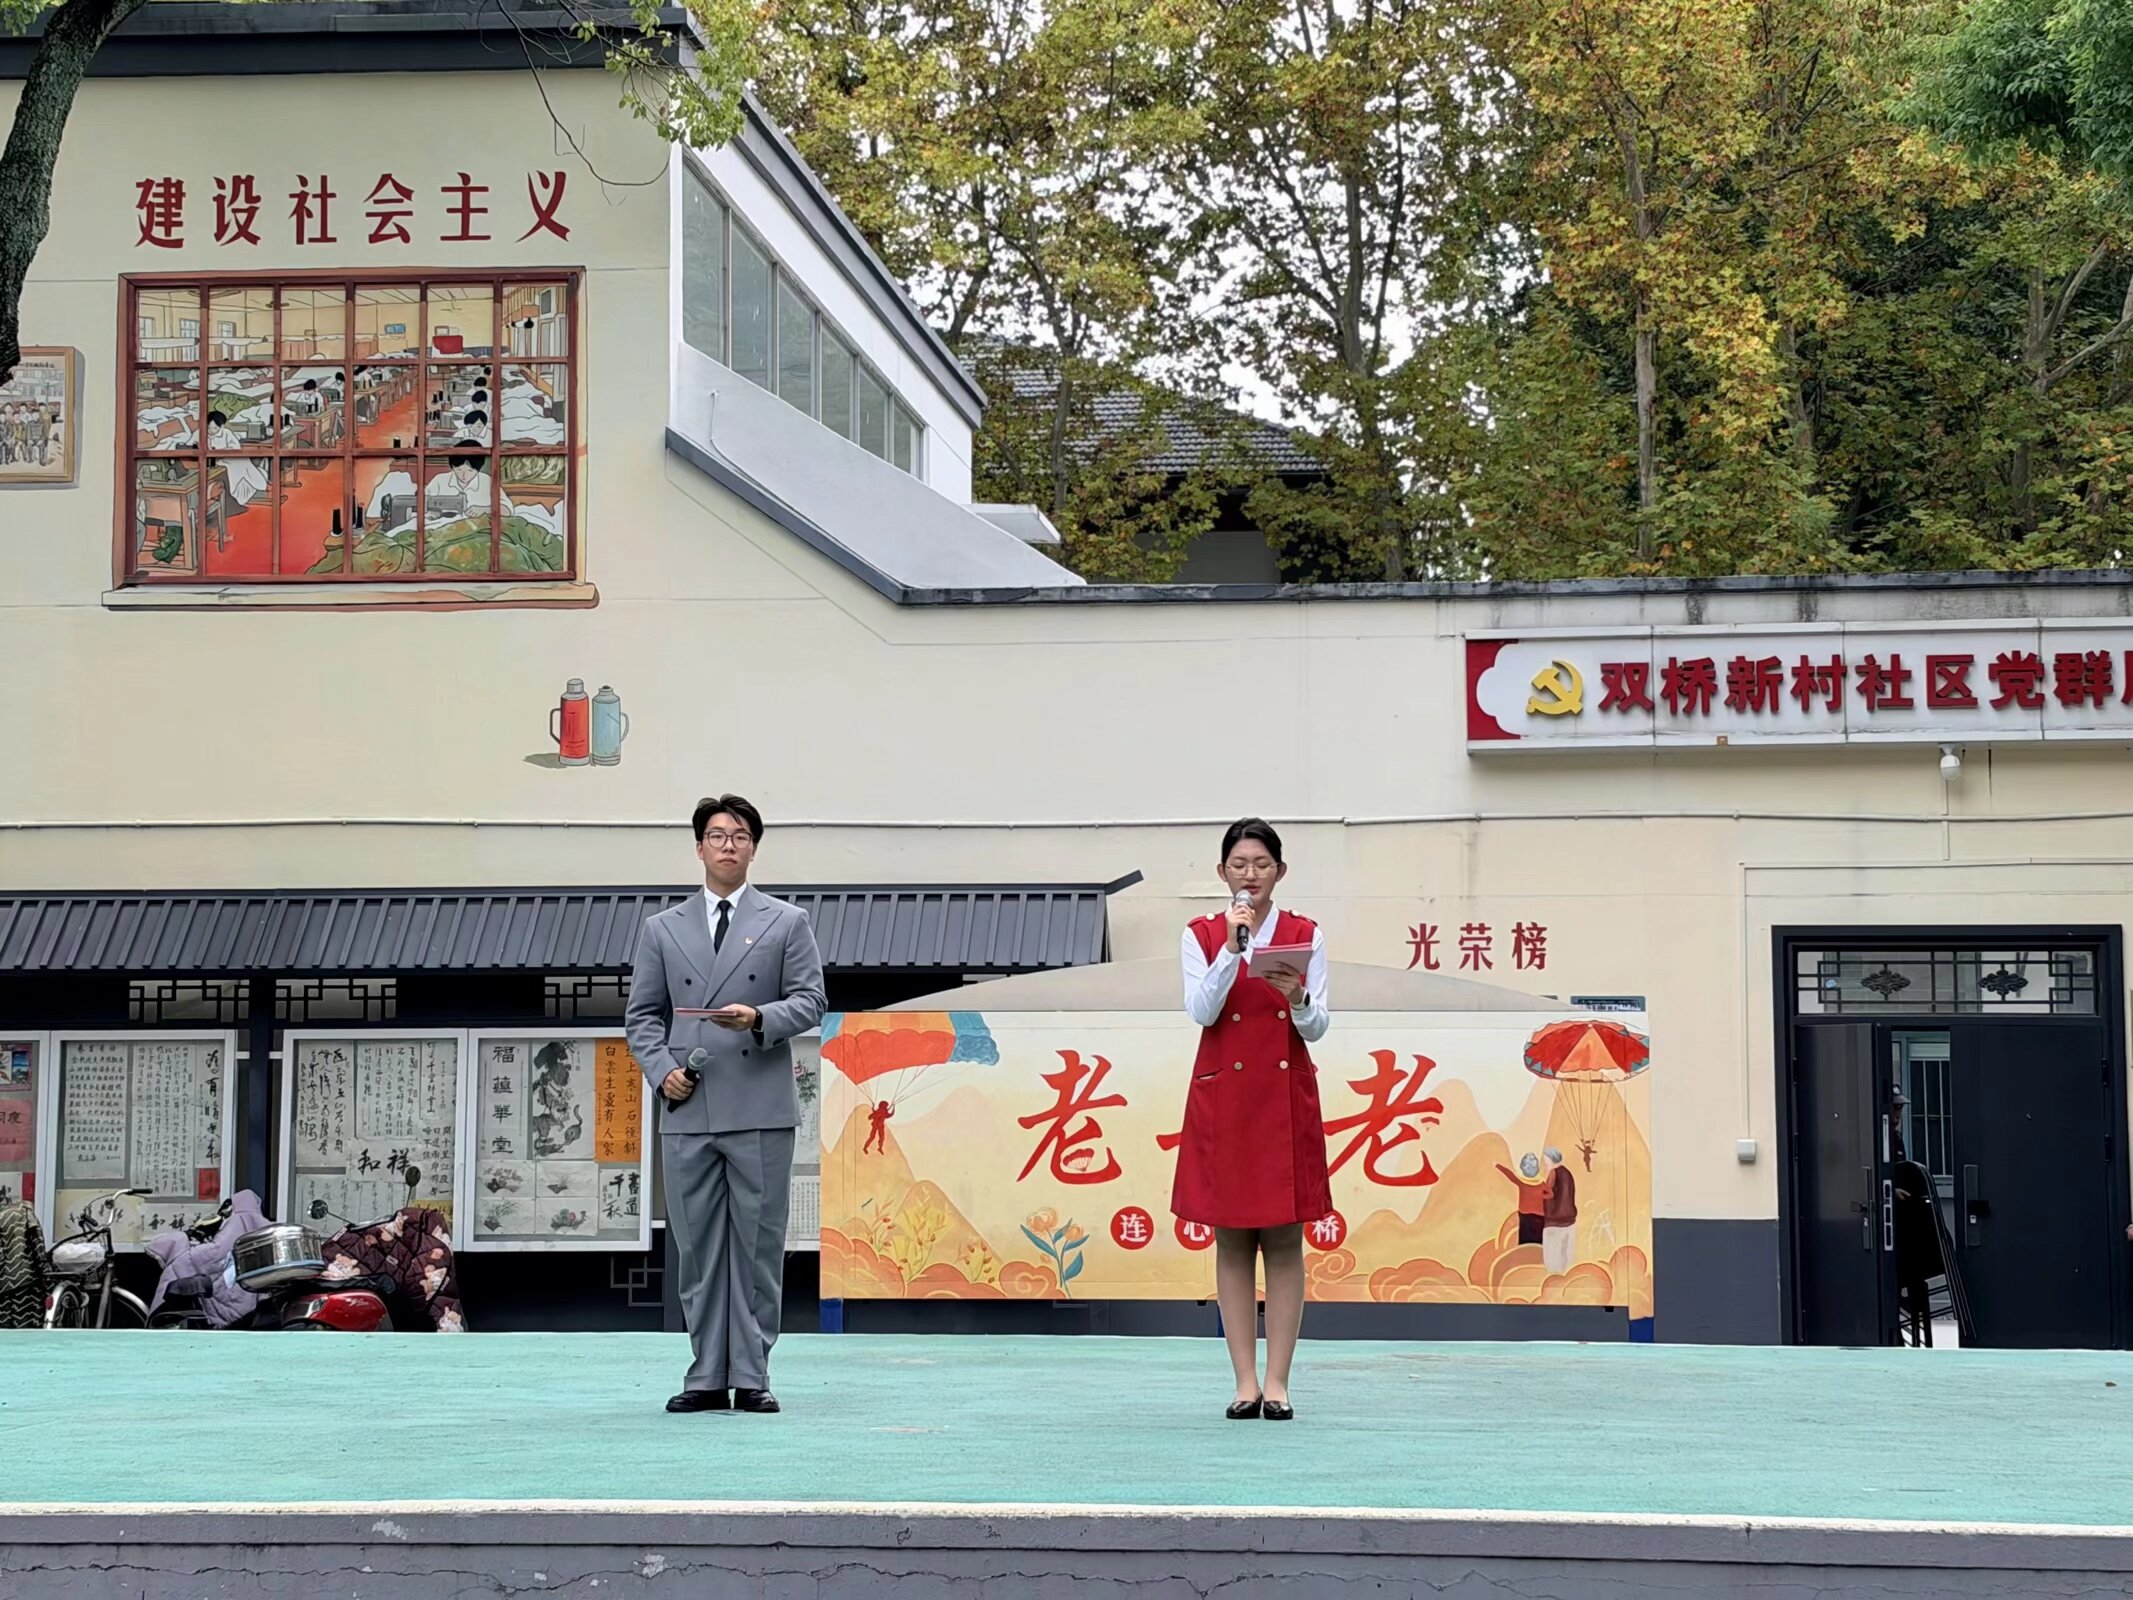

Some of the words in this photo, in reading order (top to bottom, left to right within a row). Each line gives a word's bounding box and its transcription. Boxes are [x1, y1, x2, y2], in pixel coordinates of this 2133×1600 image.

[134, 170, 571, 249] 建设社会主义
[1598, 649, 2133, 713] 双桥新村社区党群
[1405, 921, 1548, 970] 光荣榜
[1016, 1049, 1444, 1187] 老老
[1119, 1213, 1341, 1243] 连心桥
